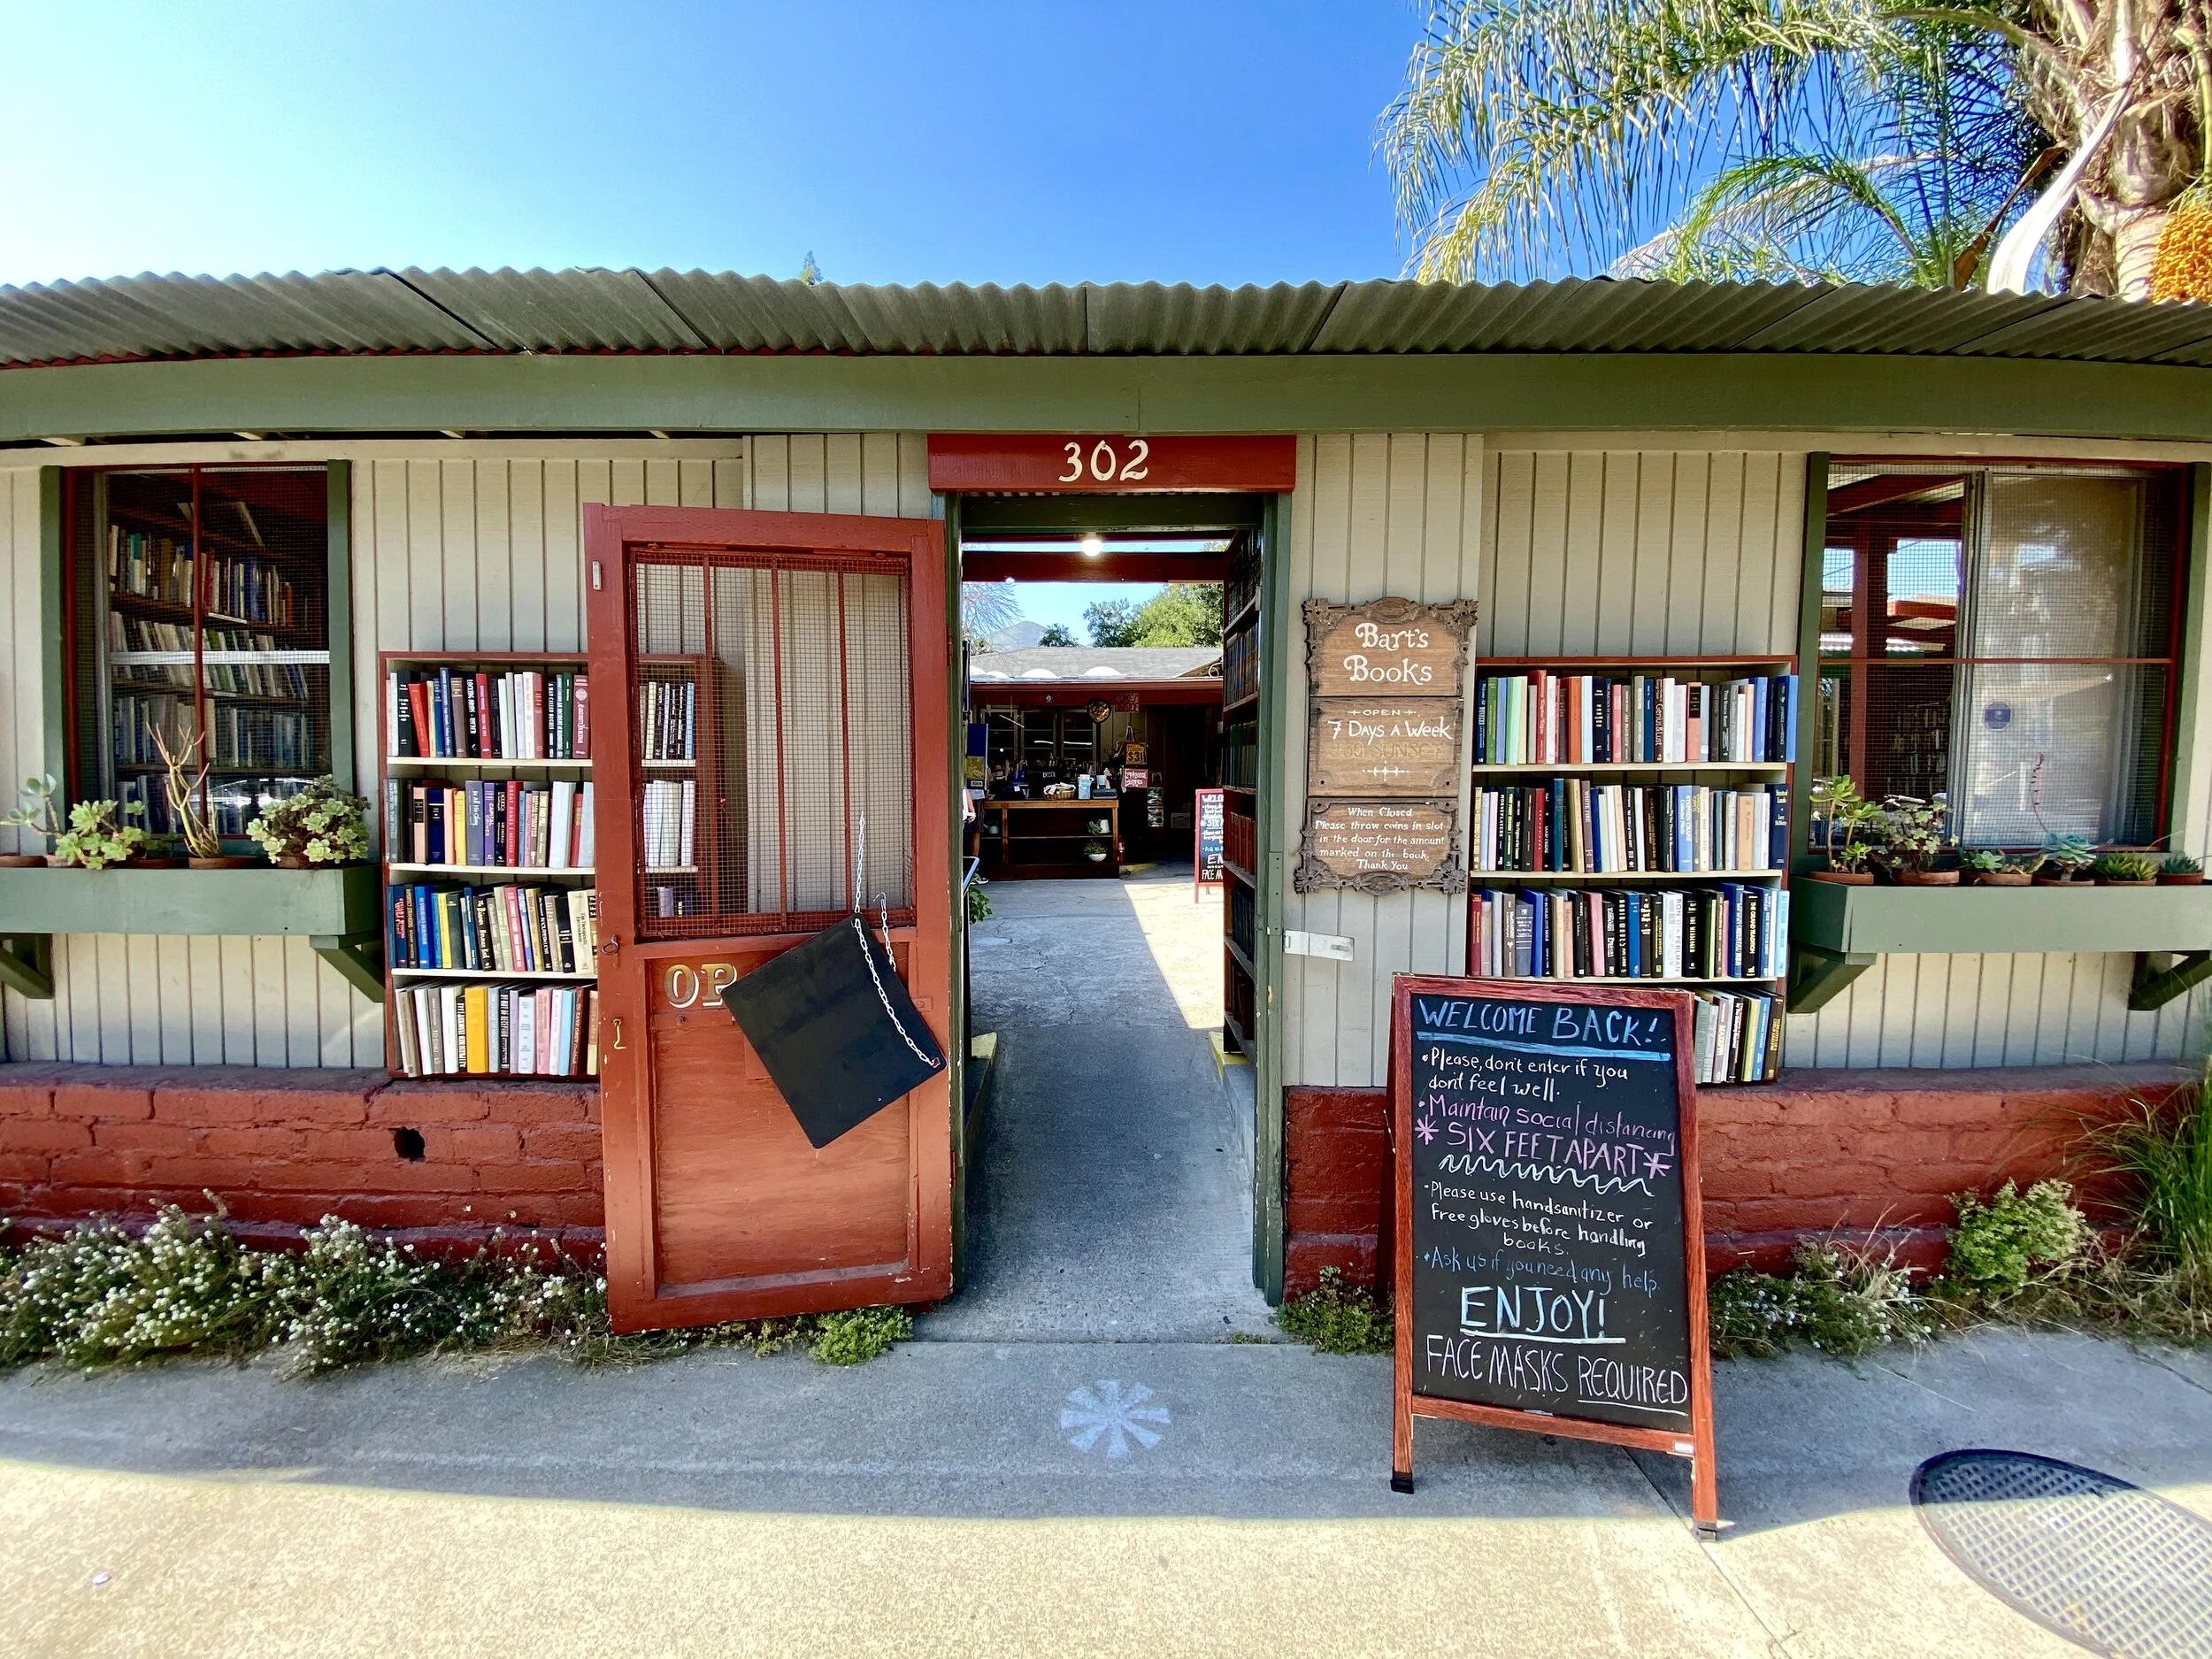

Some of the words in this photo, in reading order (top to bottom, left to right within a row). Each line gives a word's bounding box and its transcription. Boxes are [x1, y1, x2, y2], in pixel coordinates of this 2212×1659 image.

[1058, 439, 1148, 482] 302
[1355, 622, 1429, 651] Bart's
[1343, 655, 1432, 685] Books
[1327, 720, 1342, 740] 7
[1404, 716, 1454, 740] Week
[1315, 820, 1345, 830] Please
[1351, 821, 1379, 830] throw
[1411, 821, 1422, 831] in
[1425, 821, 1444, 831] slot
[1348, 807, 1373, 817] When
[1379, 807, 1413, 818] Closed
[1319, 834, 1328, 843] in
[1351, 833, 1374, 843] door
[1374, 835, 1391, 846] for
[1393, 835, 1408, 845] the
[1319, 847, 1360, 857] marked
[1356, 858, 1388, 870] Thank
[1390, 861, 1409, 871] You
[1419, 999, 1542, 1034] WELCOME
[1552, 1008, 1659, 1046] BACK!
[1528, 1057, 1571, 1074] enter
[1575, 1058, 1588, 1076] if
[1594, 1064, 1629, 1088] you
[1469, 1074, 1506, 1095] feel
[1513, 1078, 1561, 1102] well.
[1428, 1094, 1510, 1126] Maintain
[1516, 1102, 1580, 1136] social
[1447, 1121, 1496, 1155] SIX
[1504, 1131, 1564, 1164] FEET
[1563, 1139, 1645, 1177] APART
[1431, 1180, 1476, 1201] Please
[1479, 1190, 1506, 1204] use
[1512, 1190, 1624, 1223] handsanitizer
[1632, 1217, 1654, 1231] or
[1470, 1208, 1518, 1230] gloves
[1523, 1217, 1571, 1240] before
[1578, 1224, 1647, 1258] handling
[1503, 1233, 1570, 1256] books.
[1431, 1246, 1462, 1272] Ask
[1466, 1254, 1487, 1271] us
[1491, 1248, 1504, 1271] if
[1505, 1259, 1533, 1281] you
[1537, 1259, 1578, 1283] need
[1581, 1266, 1612, 1296] any
[1461, 1285, 1605, 1339] ENJOY!
[1426, 1333, 1483, 1380] FACE
[1489, 1344, 1570, 1393] MASKS
[1578, 1355, 1688, 1404] REQUIRED
